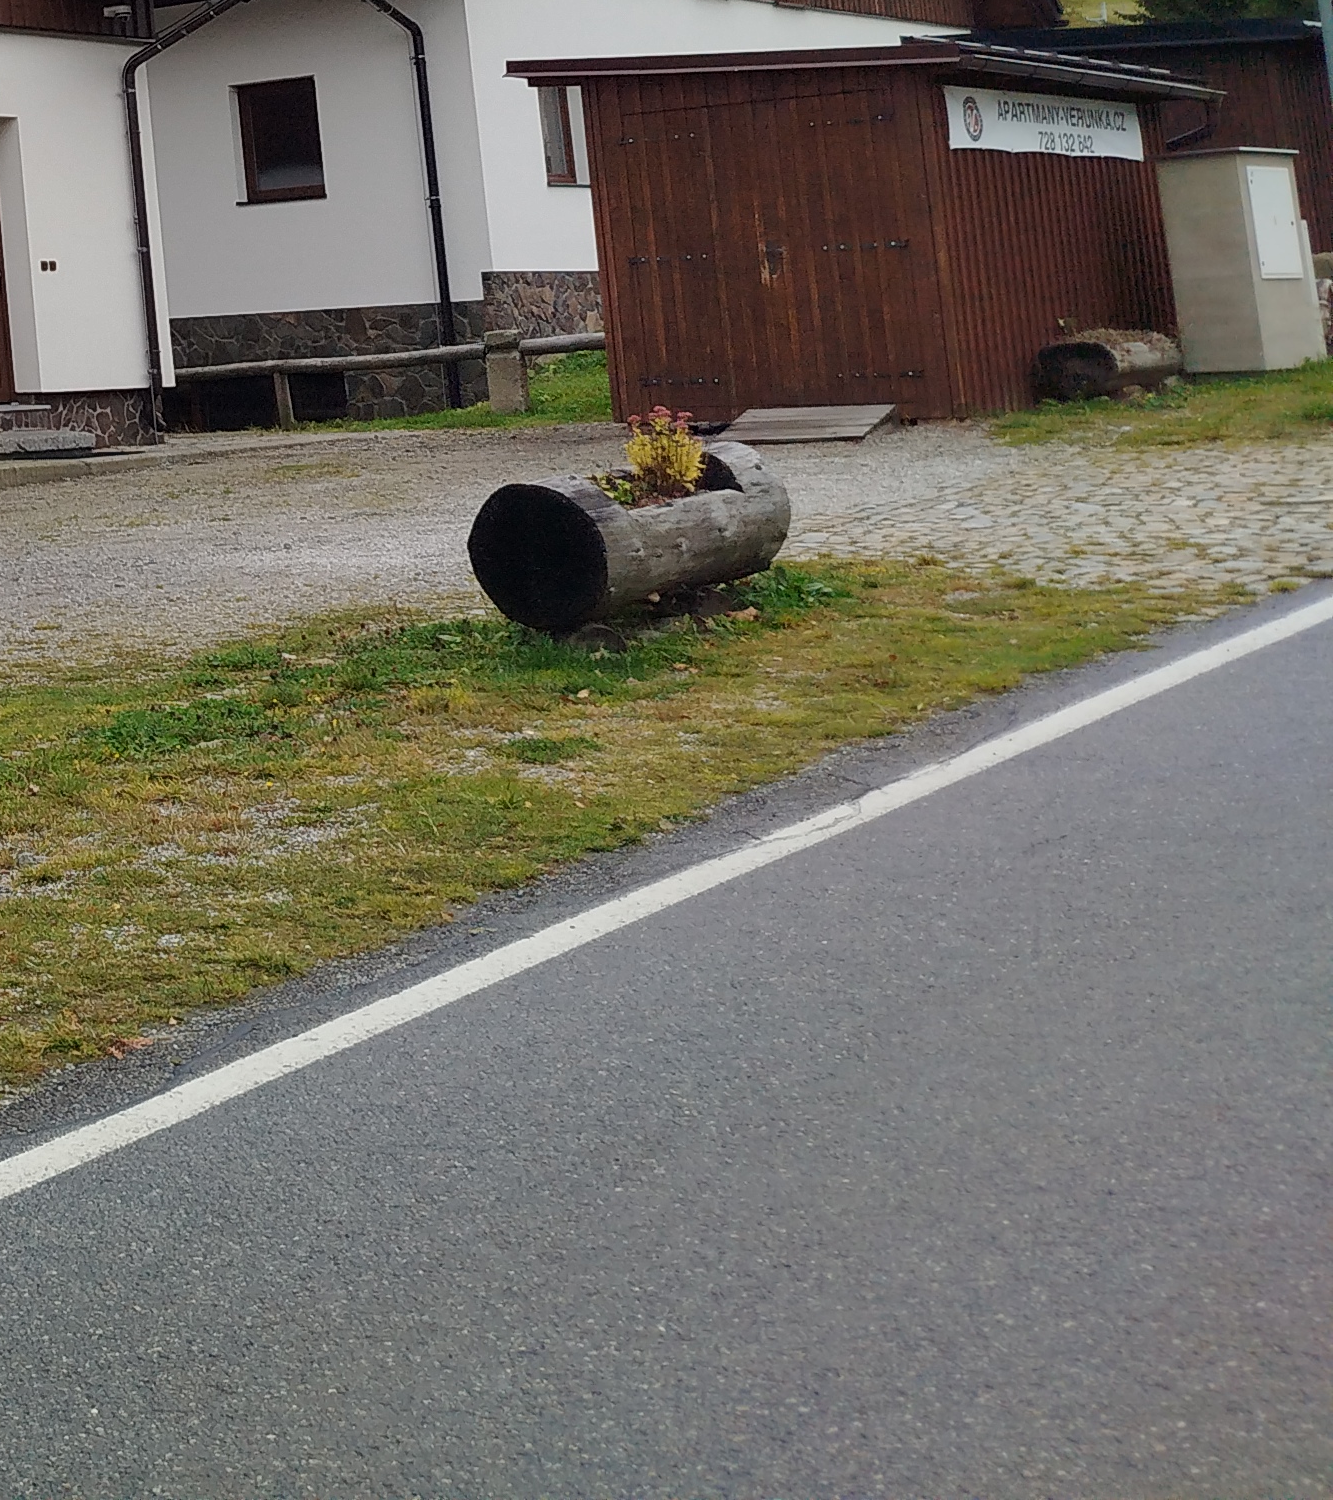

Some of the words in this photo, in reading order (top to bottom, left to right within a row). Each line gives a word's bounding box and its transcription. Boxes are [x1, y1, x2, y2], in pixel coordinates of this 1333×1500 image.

[997, 99, 1127, 132] APARTMANY-VERUNKA.CZ
[1037, 131, 1056, 151] 728
[1058, 132, 1076, 153] 132
